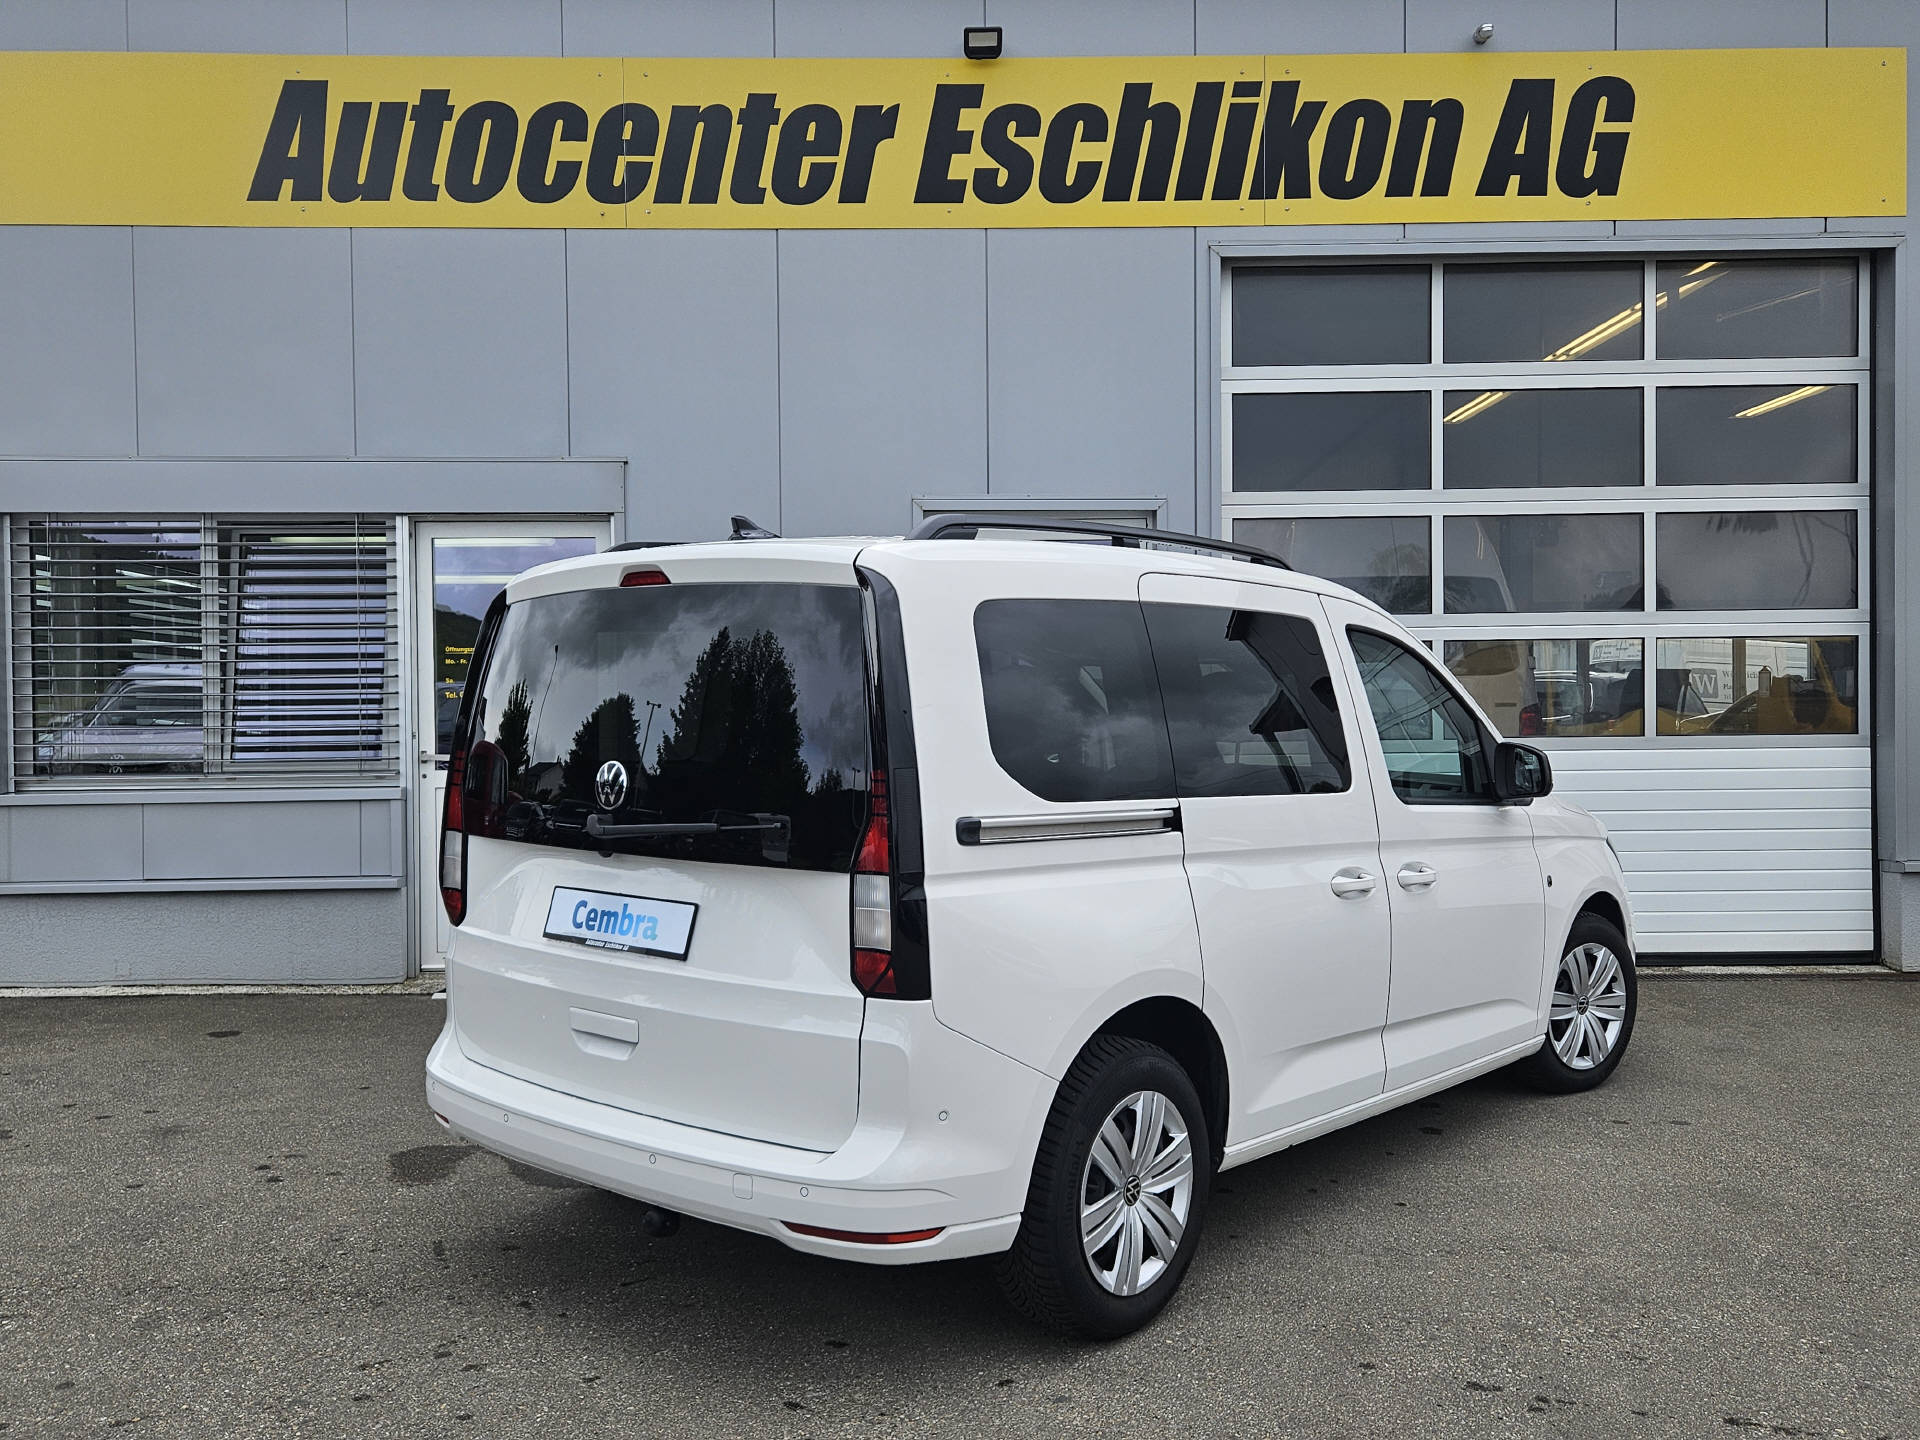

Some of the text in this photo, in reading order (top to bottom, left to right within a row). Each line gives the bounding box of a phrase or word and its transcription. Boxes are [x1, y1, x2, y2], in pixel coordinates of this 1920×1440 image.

[247, 76, 1636, 205] Autocenter Eschlikon AG
[445, 691, 458, 699] Tel.
[572, 900, 659, 941] Cembra
